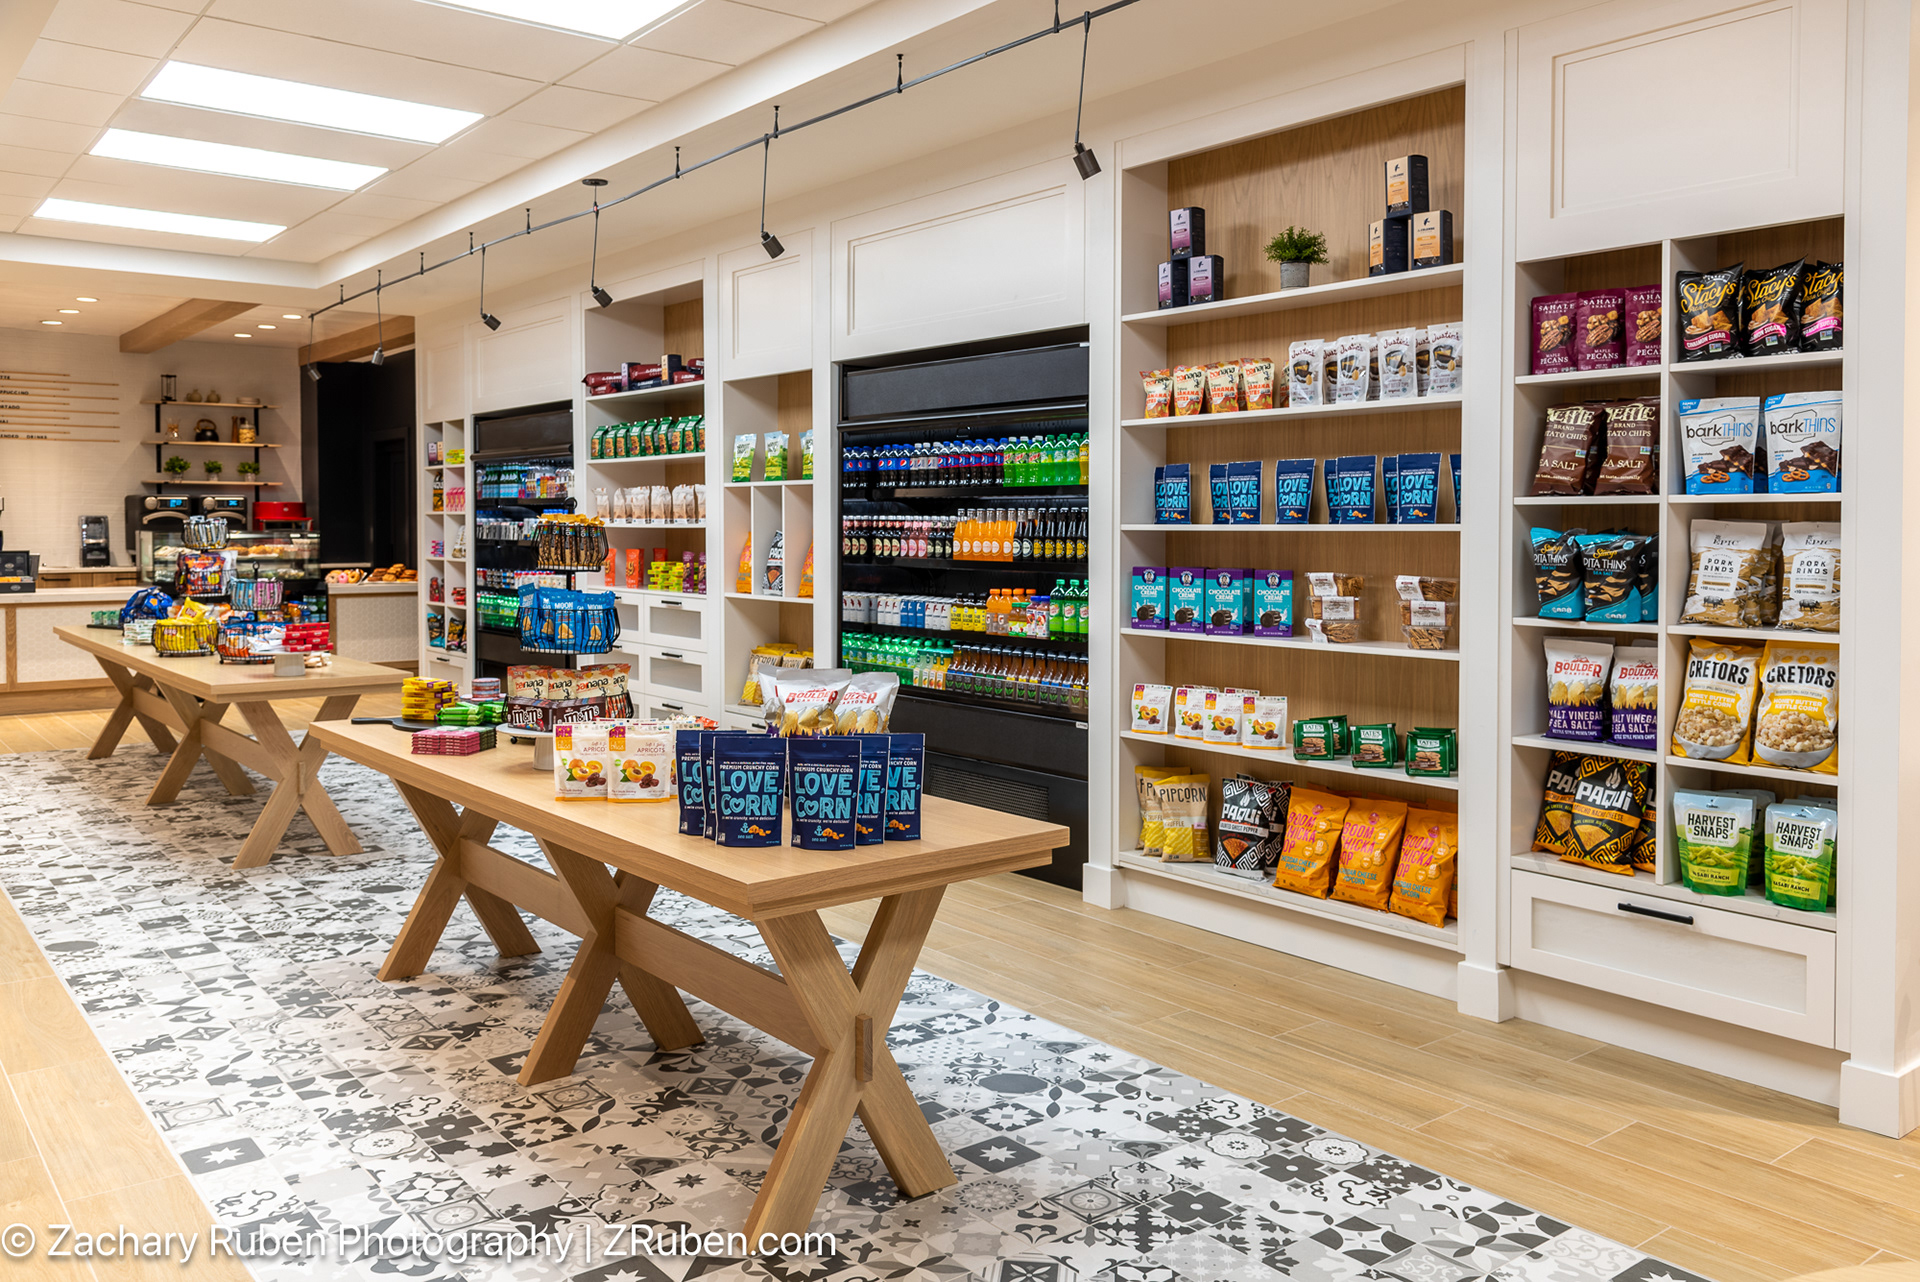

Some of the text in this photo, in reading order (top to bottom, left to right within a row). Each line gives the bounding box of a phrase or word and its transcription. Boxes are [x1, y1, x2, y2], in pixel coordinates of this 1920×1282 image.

[1680, 281, 1737, 313] Stacy's
[1747, 275, 1797, 309] Stacy's
[1538, 303, 1576, 312] SAHALE
[1583, 298, 1623, 306] SAHALE
[1818, 318, 1838, 329] SUGAR
[1431, 331, 1461, 343] Justin's
[1686, 337, 1709, 348] CINNAMON
[1384, 338, 1410, 349] Justin's
[1540, 356, 1569, 365] PECANS
[1686, 422, 1753, 439] barkTHINS
[1770, 417, 1836, 436] barkTHINS
[1566, 432, 1588, 440] CHIPS
[1551, 460, 1578, 471] SALT
[1617, 459, 1644, 469] SALT
[1230, 480, 1261, 496] LOVE,
[1279, 479, 1311, 494] LOVE,
[1339, 477, 1374, 493] LOVE,
[1400, 475, 1437, 491] LOVE,
[1231, 494, 1258, 508] CORN
[1279, 493, 1308, 507] CORN
[1340, 490, 1371, 506] CORN
[1401, 489, 1433, 505] CORN
[1533, 553, 1568, 564] PITA THINS
[1583, 557, 1627, 570] PITA THINS
[1707, 558, 1733, 566] PORK
[1704, 565, 1734, 573] RINDS
[1796, 567, 1828, 575] RINDS
[1554, 661, 1602, 678] BOULDER
[1618, 667, 1658, 679] BOULDER
[1689, 660, 1750, 686] CRETORS
[1766, 665, 1836, 689] CRETORS
[785, 690, 839, 704] BOULDER
[1709, 694, 1736, 704] BUTTER
[1795, 699, 1823, 707] BUTTER
[1689, 698, 1732, 709] KETTLE CORN
[1798, 704, 1819, 713] CORN
[1568, 710, 1603, 720] VINEGAR
[1553, 719, 1593, 730] SEA SALT
[1614, 724, 1649, 733] SEA SALT
[720, 770, 783, 796] LOVE,
[794, 772, 857, 798] LOVE,
[1160, 787, 1207, 803] PIPCORN
[721, 793, 778, 816] CORN
[795, 795, 852, 819] CORN
[1288, 811, 1317, 828] BOOM
[1605, 812, 1624, 822] CHEESE
[1687, 813, 1736, 831] HARVEST
[1343, 821, 1375, 840] BOOM
[1693, 825, 1729, 840] SNAPS
[1776, 821, 1822, 841] HARVEST
[1404, 834, 1435, 852] BOOM
[1780, 834, 1814, 850] SNAPS
[1284, 863, 1306, 873] POPCORN
[1343, 876, 1366, 886] POPCORN
[1358, 871, 1377, 881] CHEESE
[1710, 873, 1730, 881] RANCH
[1411, 884, 1432, 895] CHEESE
[1790, 884, 1810, 892] RANCH
